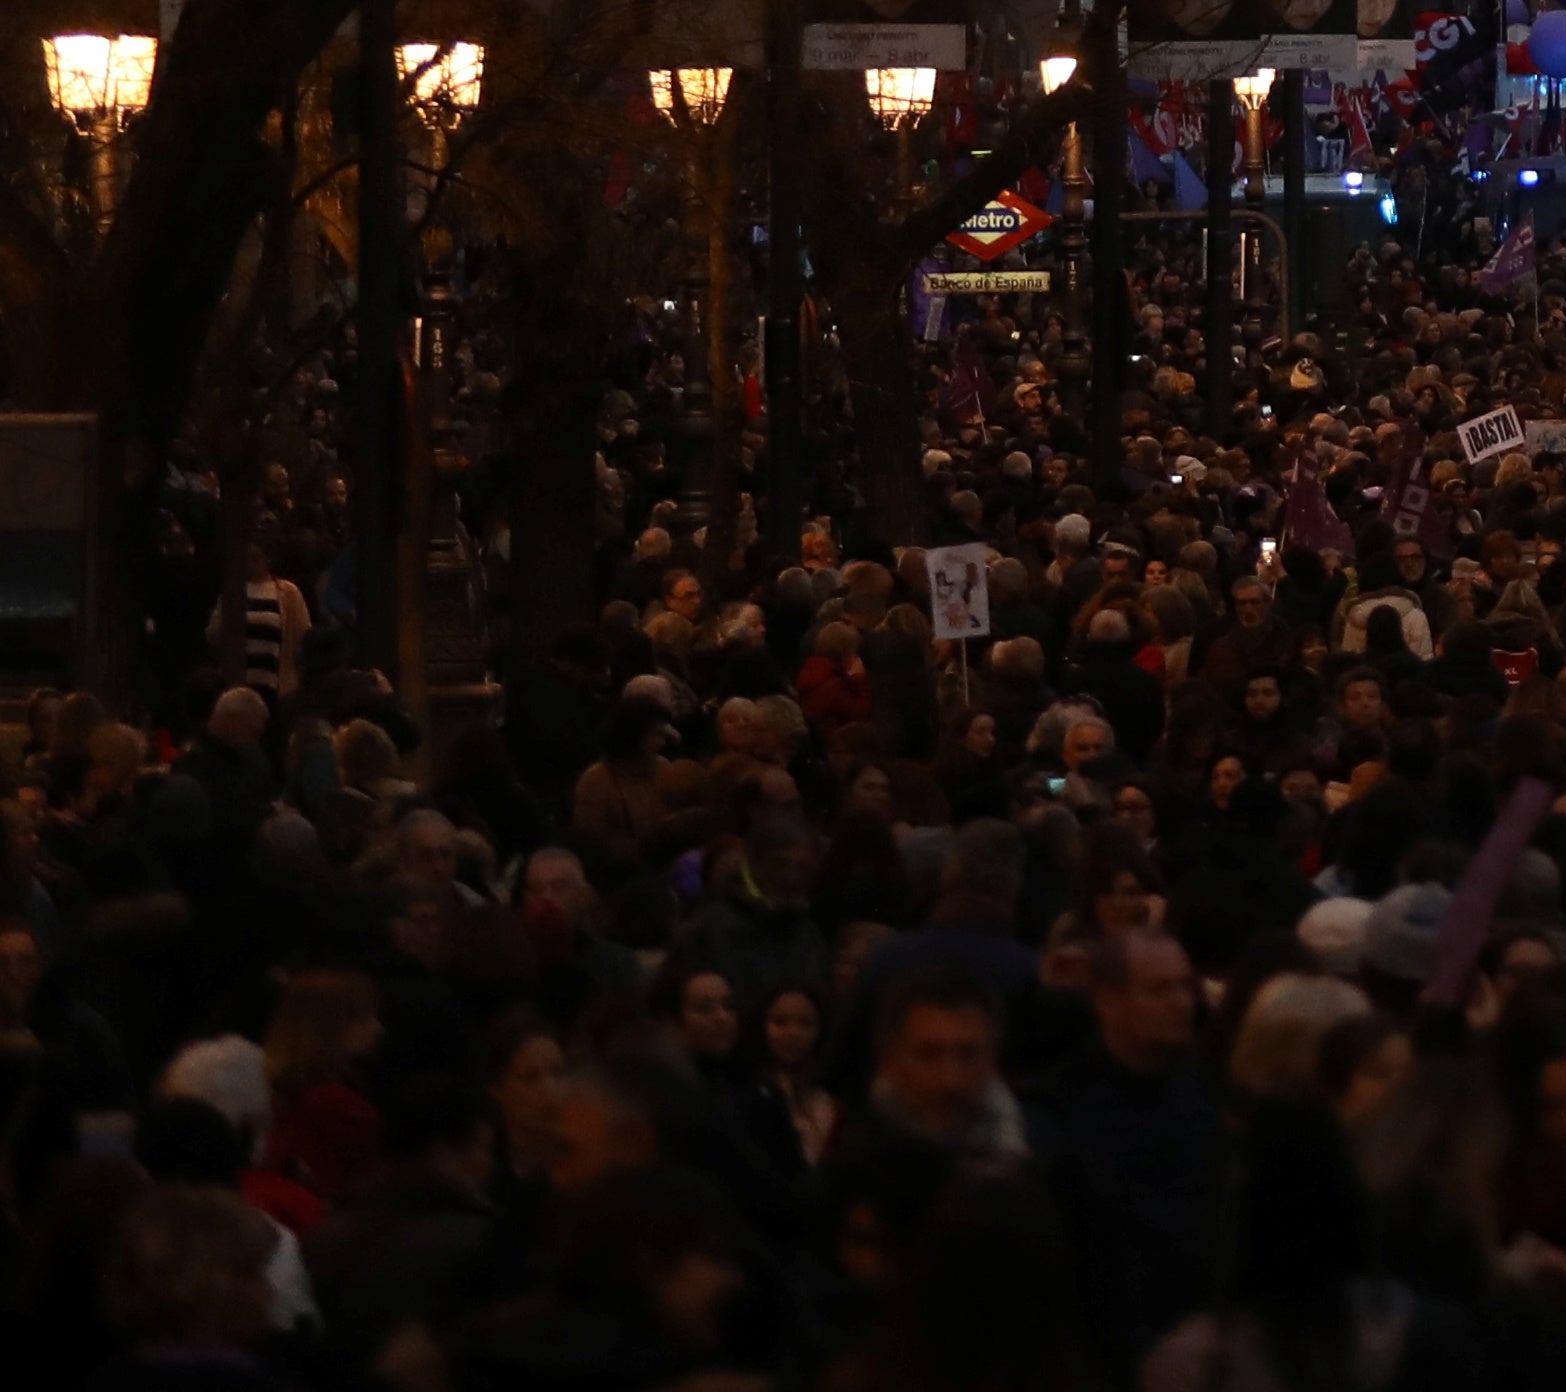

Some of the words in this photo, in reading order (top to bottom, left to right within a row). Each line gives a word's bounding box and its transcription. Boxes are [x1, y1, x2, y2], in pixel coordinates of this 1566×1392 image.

[960, 212, 1016, 228] Metro
[930, 277, 972, 290] Banco
[975, 276, 992, 290] de
[995, 276, 1043, 290] España
[1465, 409, 1519, 458] ¡BASTA!
